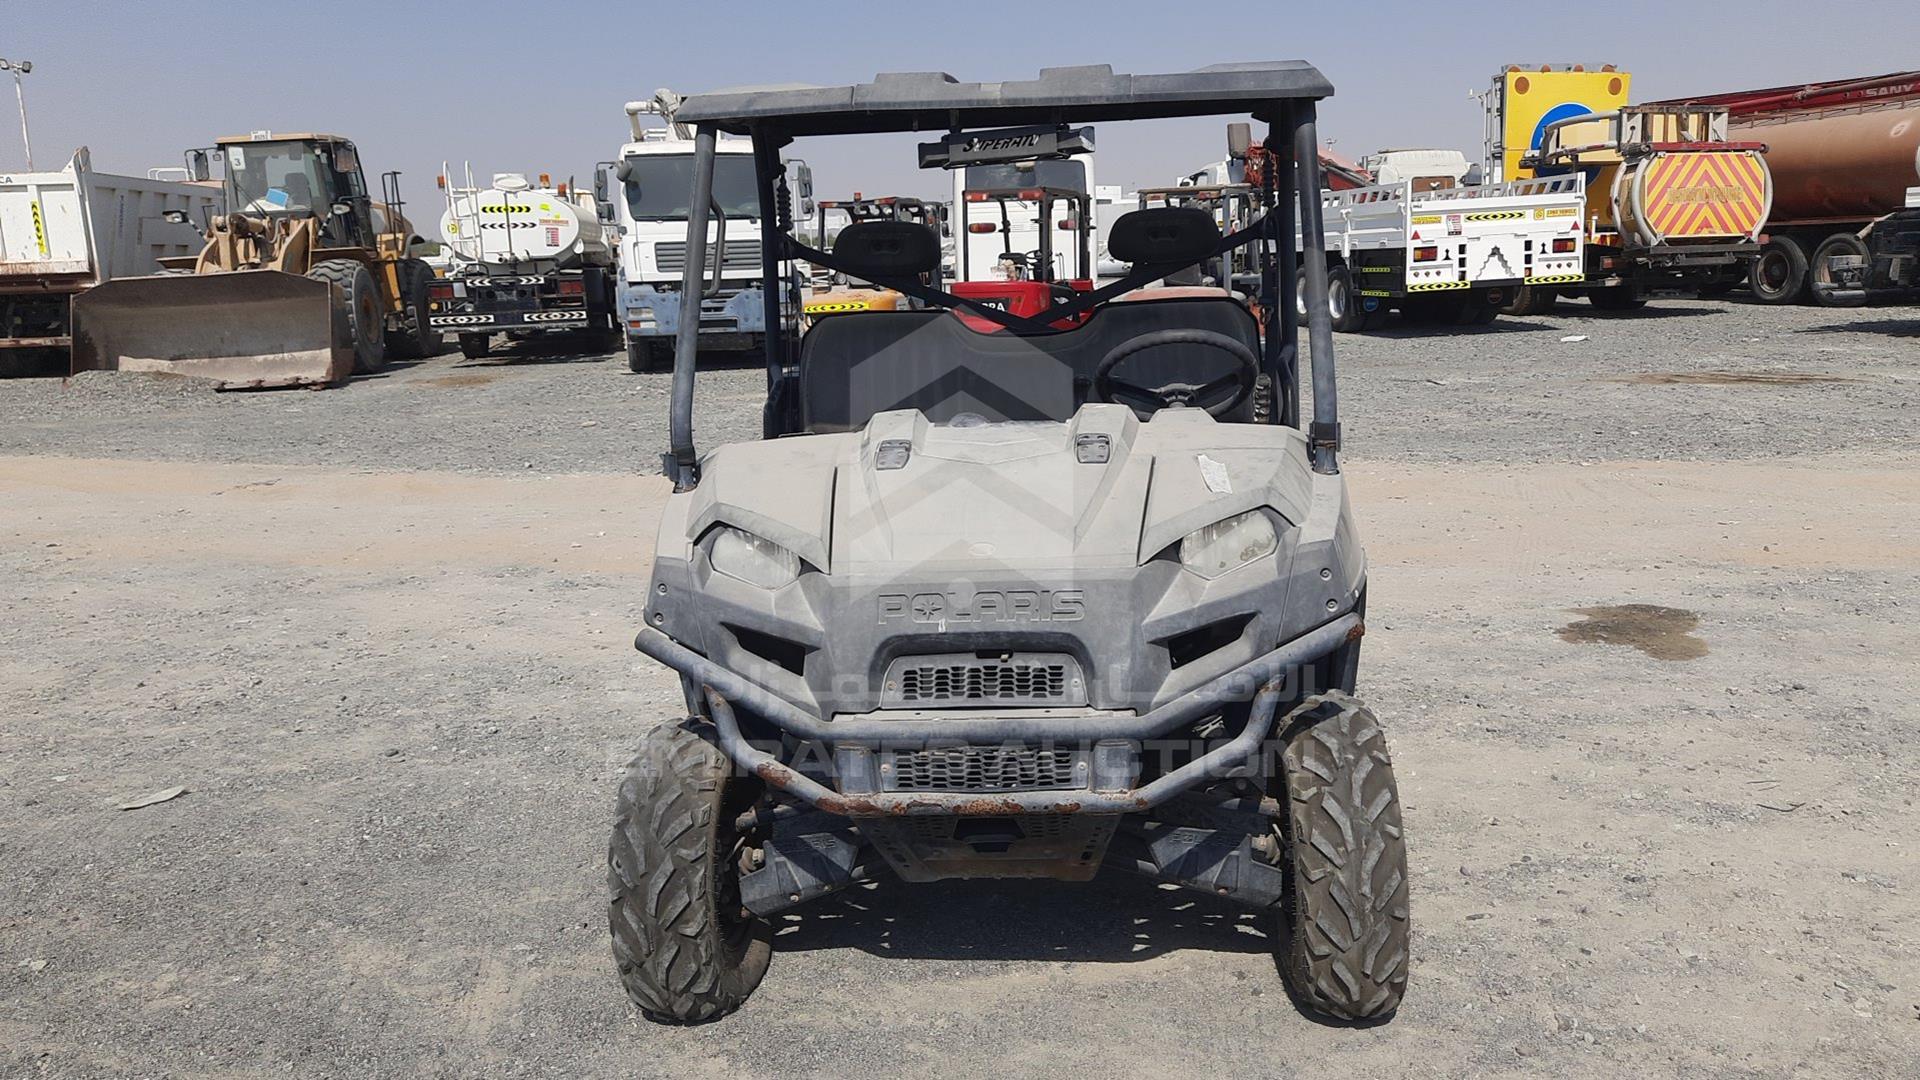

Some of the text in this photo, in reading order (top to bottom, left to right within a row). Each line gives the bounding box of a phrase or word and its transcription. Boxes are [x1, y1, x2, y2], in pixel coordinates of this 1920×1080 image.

[1865, 83, 1915, 97] SANY
[234, 158, 241, 167] 3
[878, 590, 1085, 624] POLARIS
